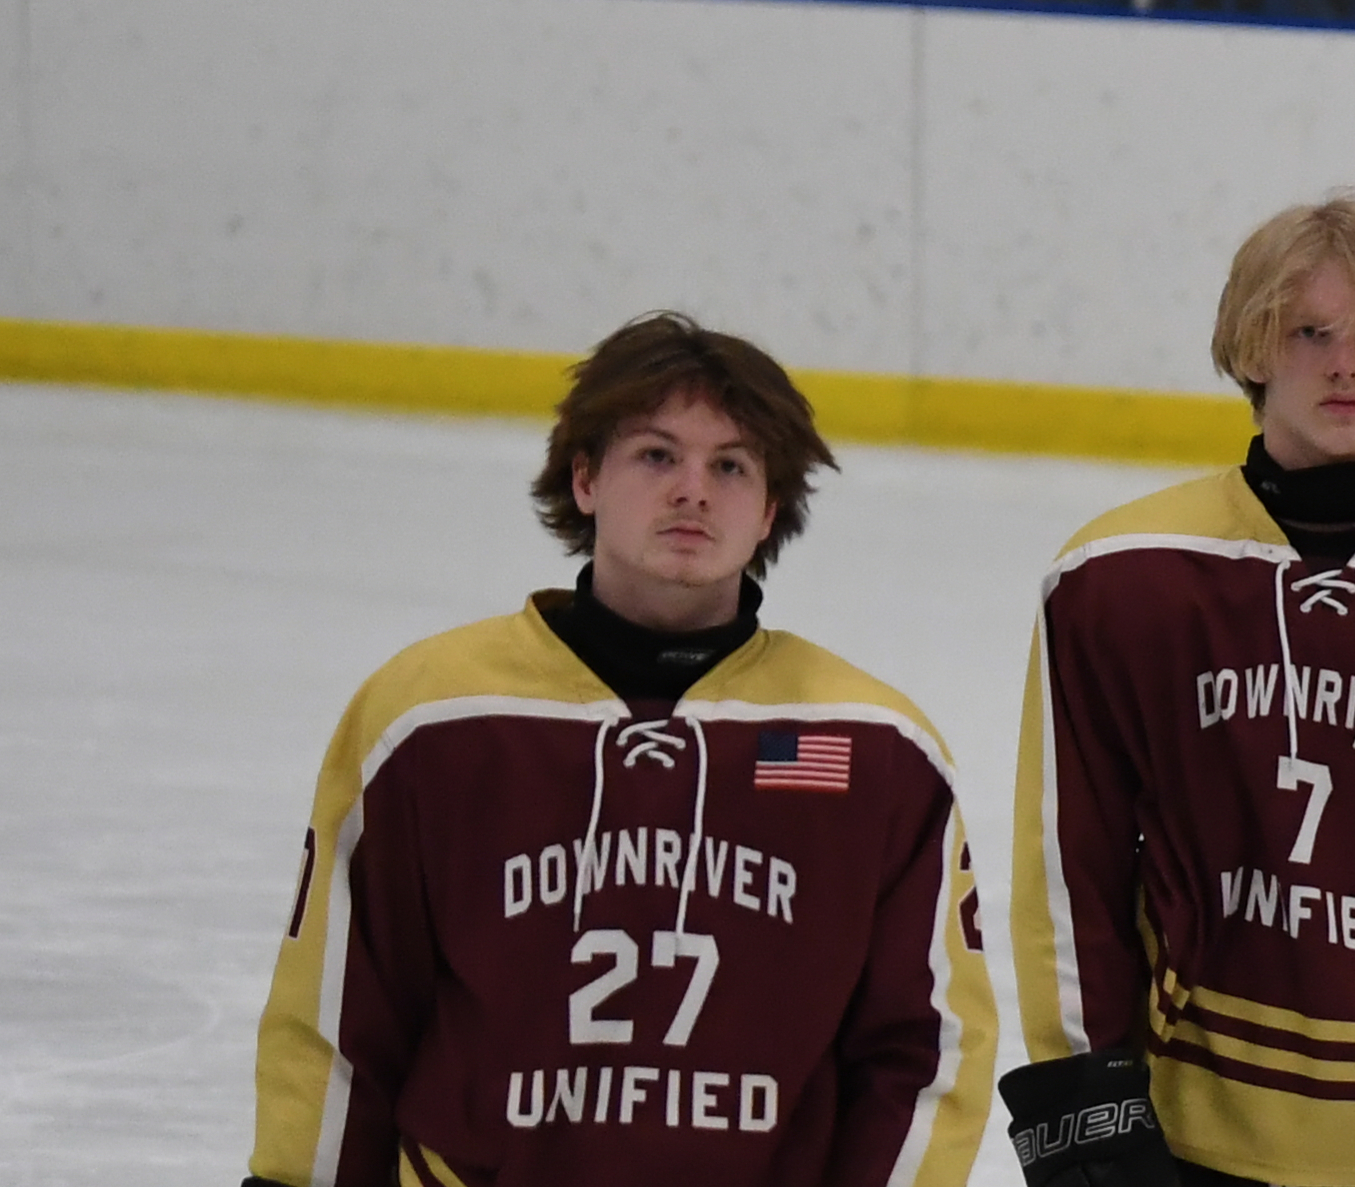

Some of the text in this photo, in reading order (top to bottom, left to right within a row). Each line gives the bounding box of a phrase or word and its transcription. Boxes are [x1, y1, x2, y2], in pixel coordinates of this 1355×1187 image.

[1276, 755, 1334, 864] 7
[503, 826, 798, 925] DOWNRIVER
[567, 929, 721, 1047] 27
[505, 1066, 780, 1133] UNIFIED
